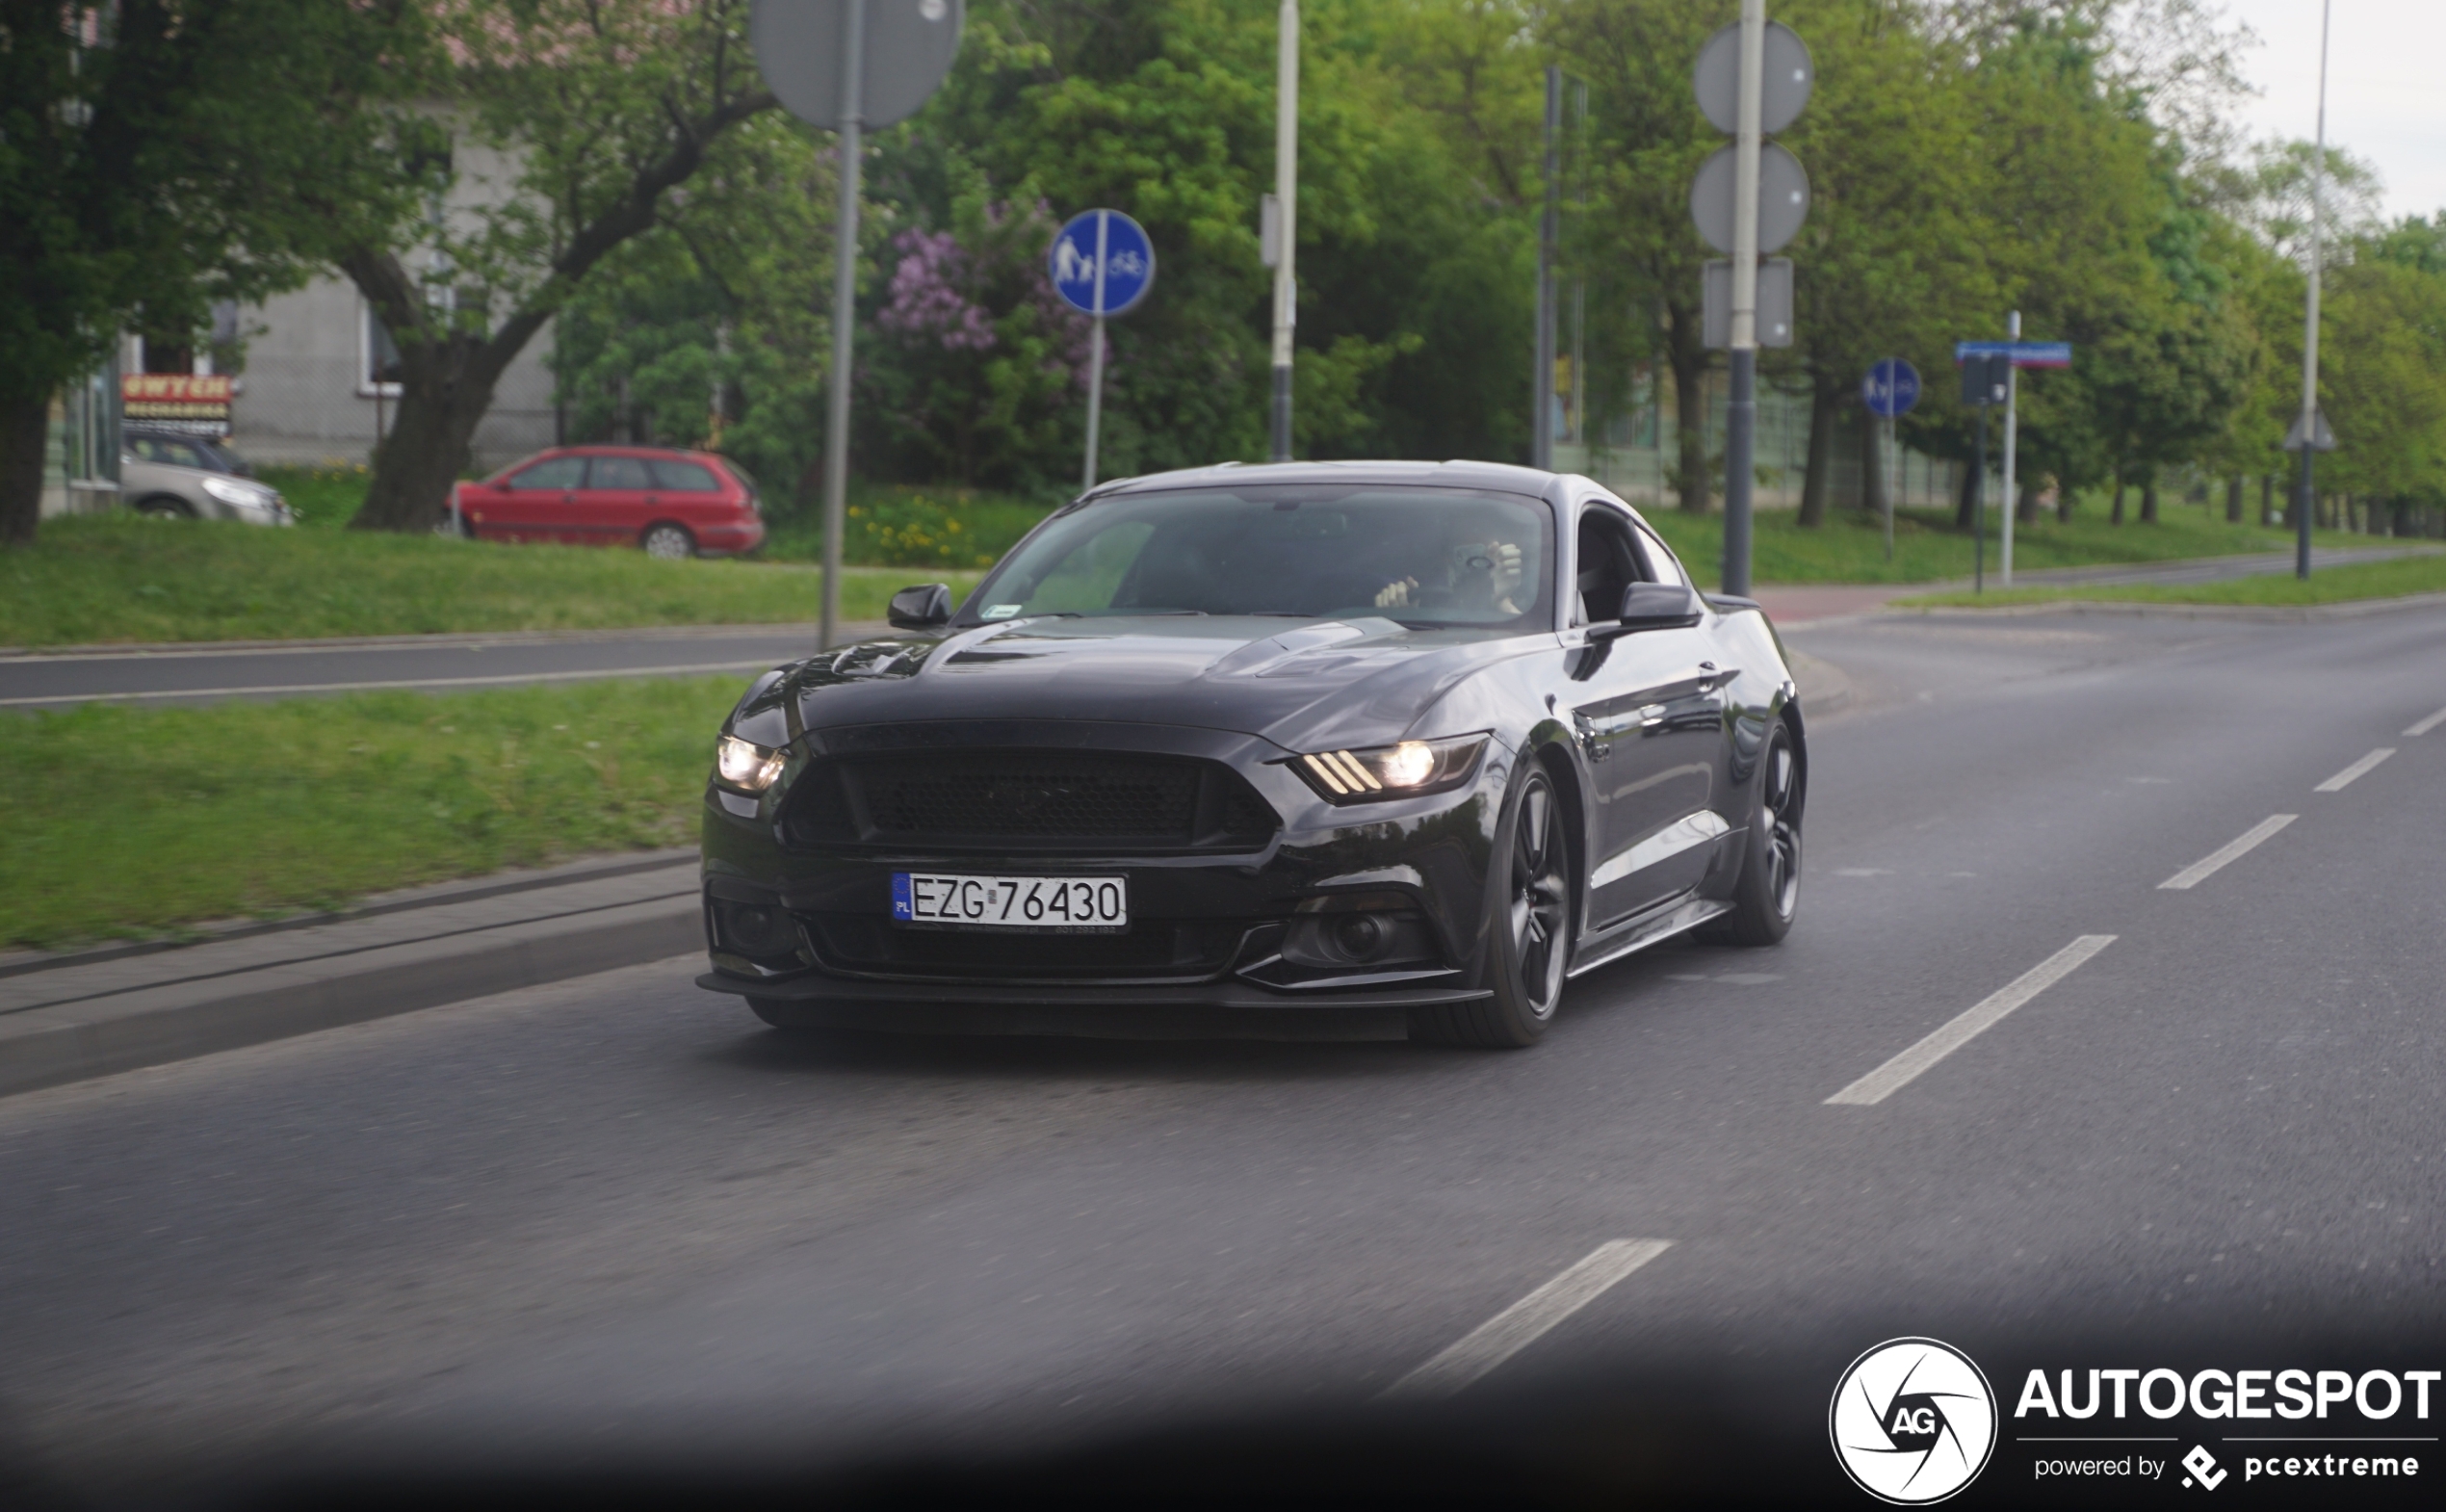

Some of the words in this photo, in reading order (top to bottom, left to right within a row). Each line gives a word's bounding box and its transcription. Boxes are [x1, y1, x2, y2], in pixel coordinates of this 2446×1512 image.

[896, 901, 910, 913] PL
[913, 877, 984, 919] EZG
[998, 881, 1120, 922] 76430
